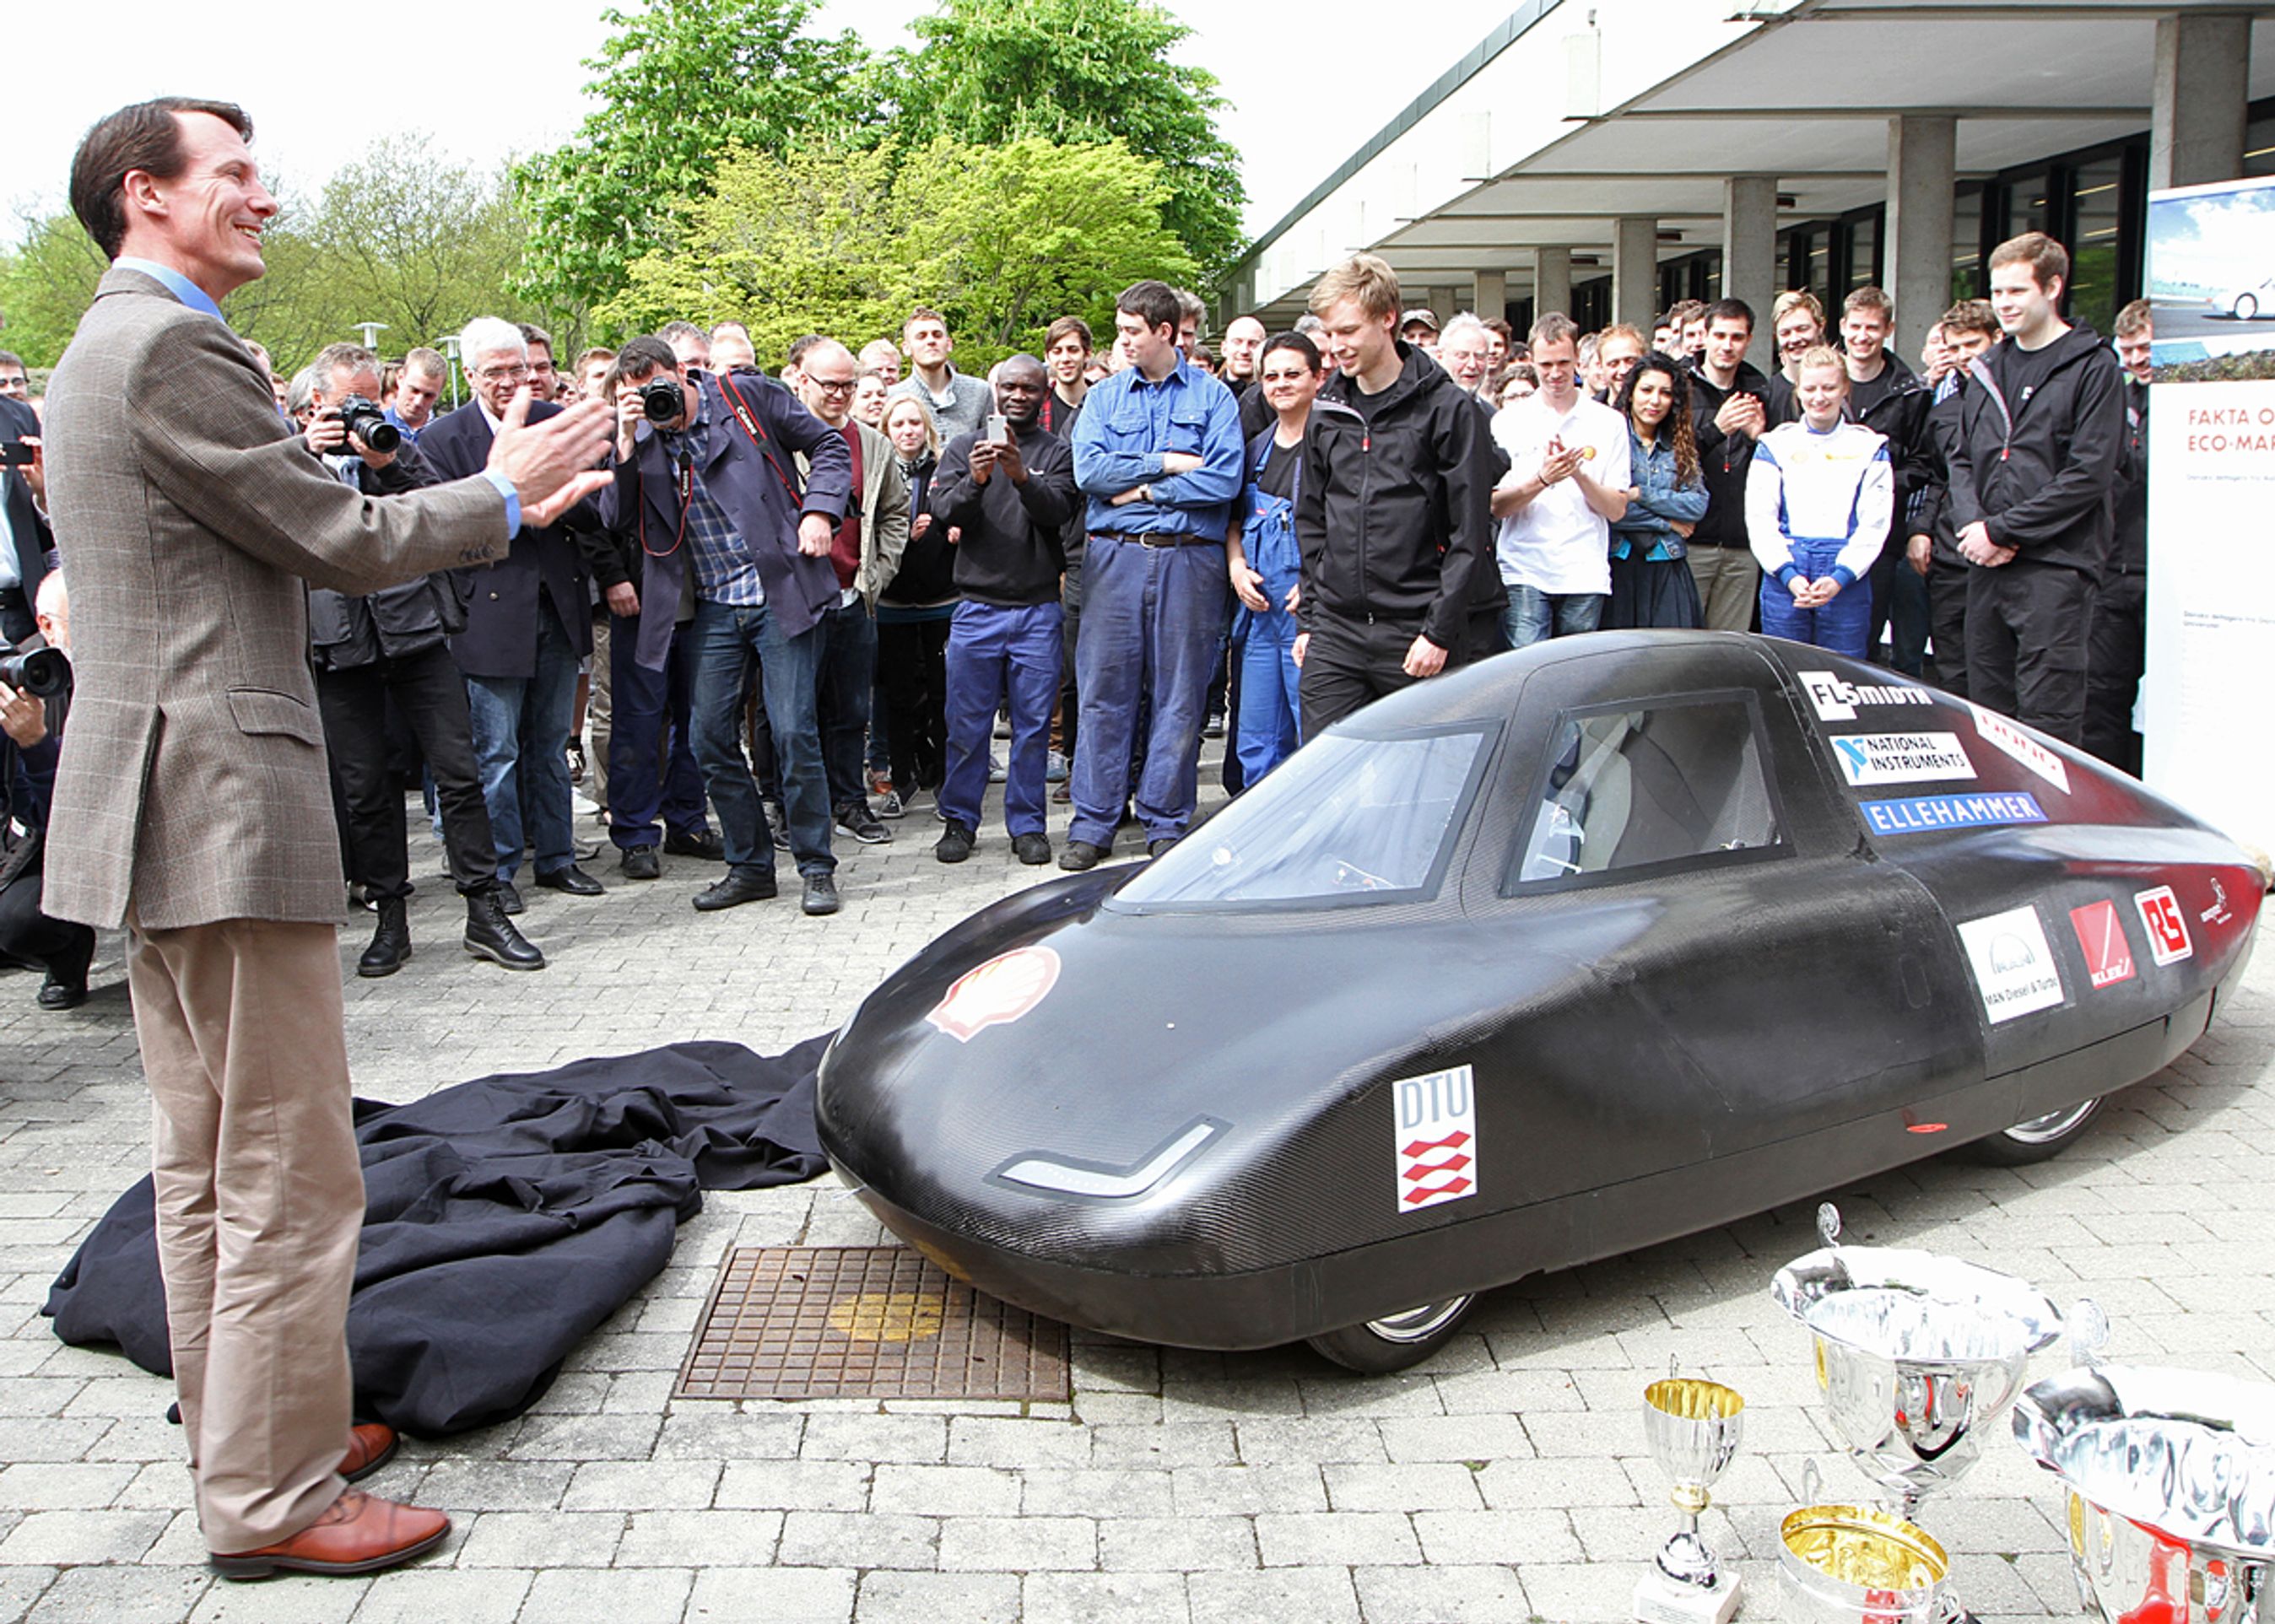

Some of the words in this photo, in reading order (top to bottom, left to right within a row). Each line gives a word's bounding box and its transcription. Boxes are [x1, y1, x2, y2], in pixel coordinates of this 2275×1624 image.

[737, 405, 758, 435] Canon
[2188, 408, 2250, 425] FAKTA
[1867, 736, 1937, 753] NATIONAL
[1870, 753, 1967, 771] INSTRUMENTS
[1869, 796, 2040, 830] ELLEHAMMER
[2141, 895, 2187, 957] RS
[1985, 991, 2005, 1006] MAN
[1401, 1069, 1468, 1130] DTU
